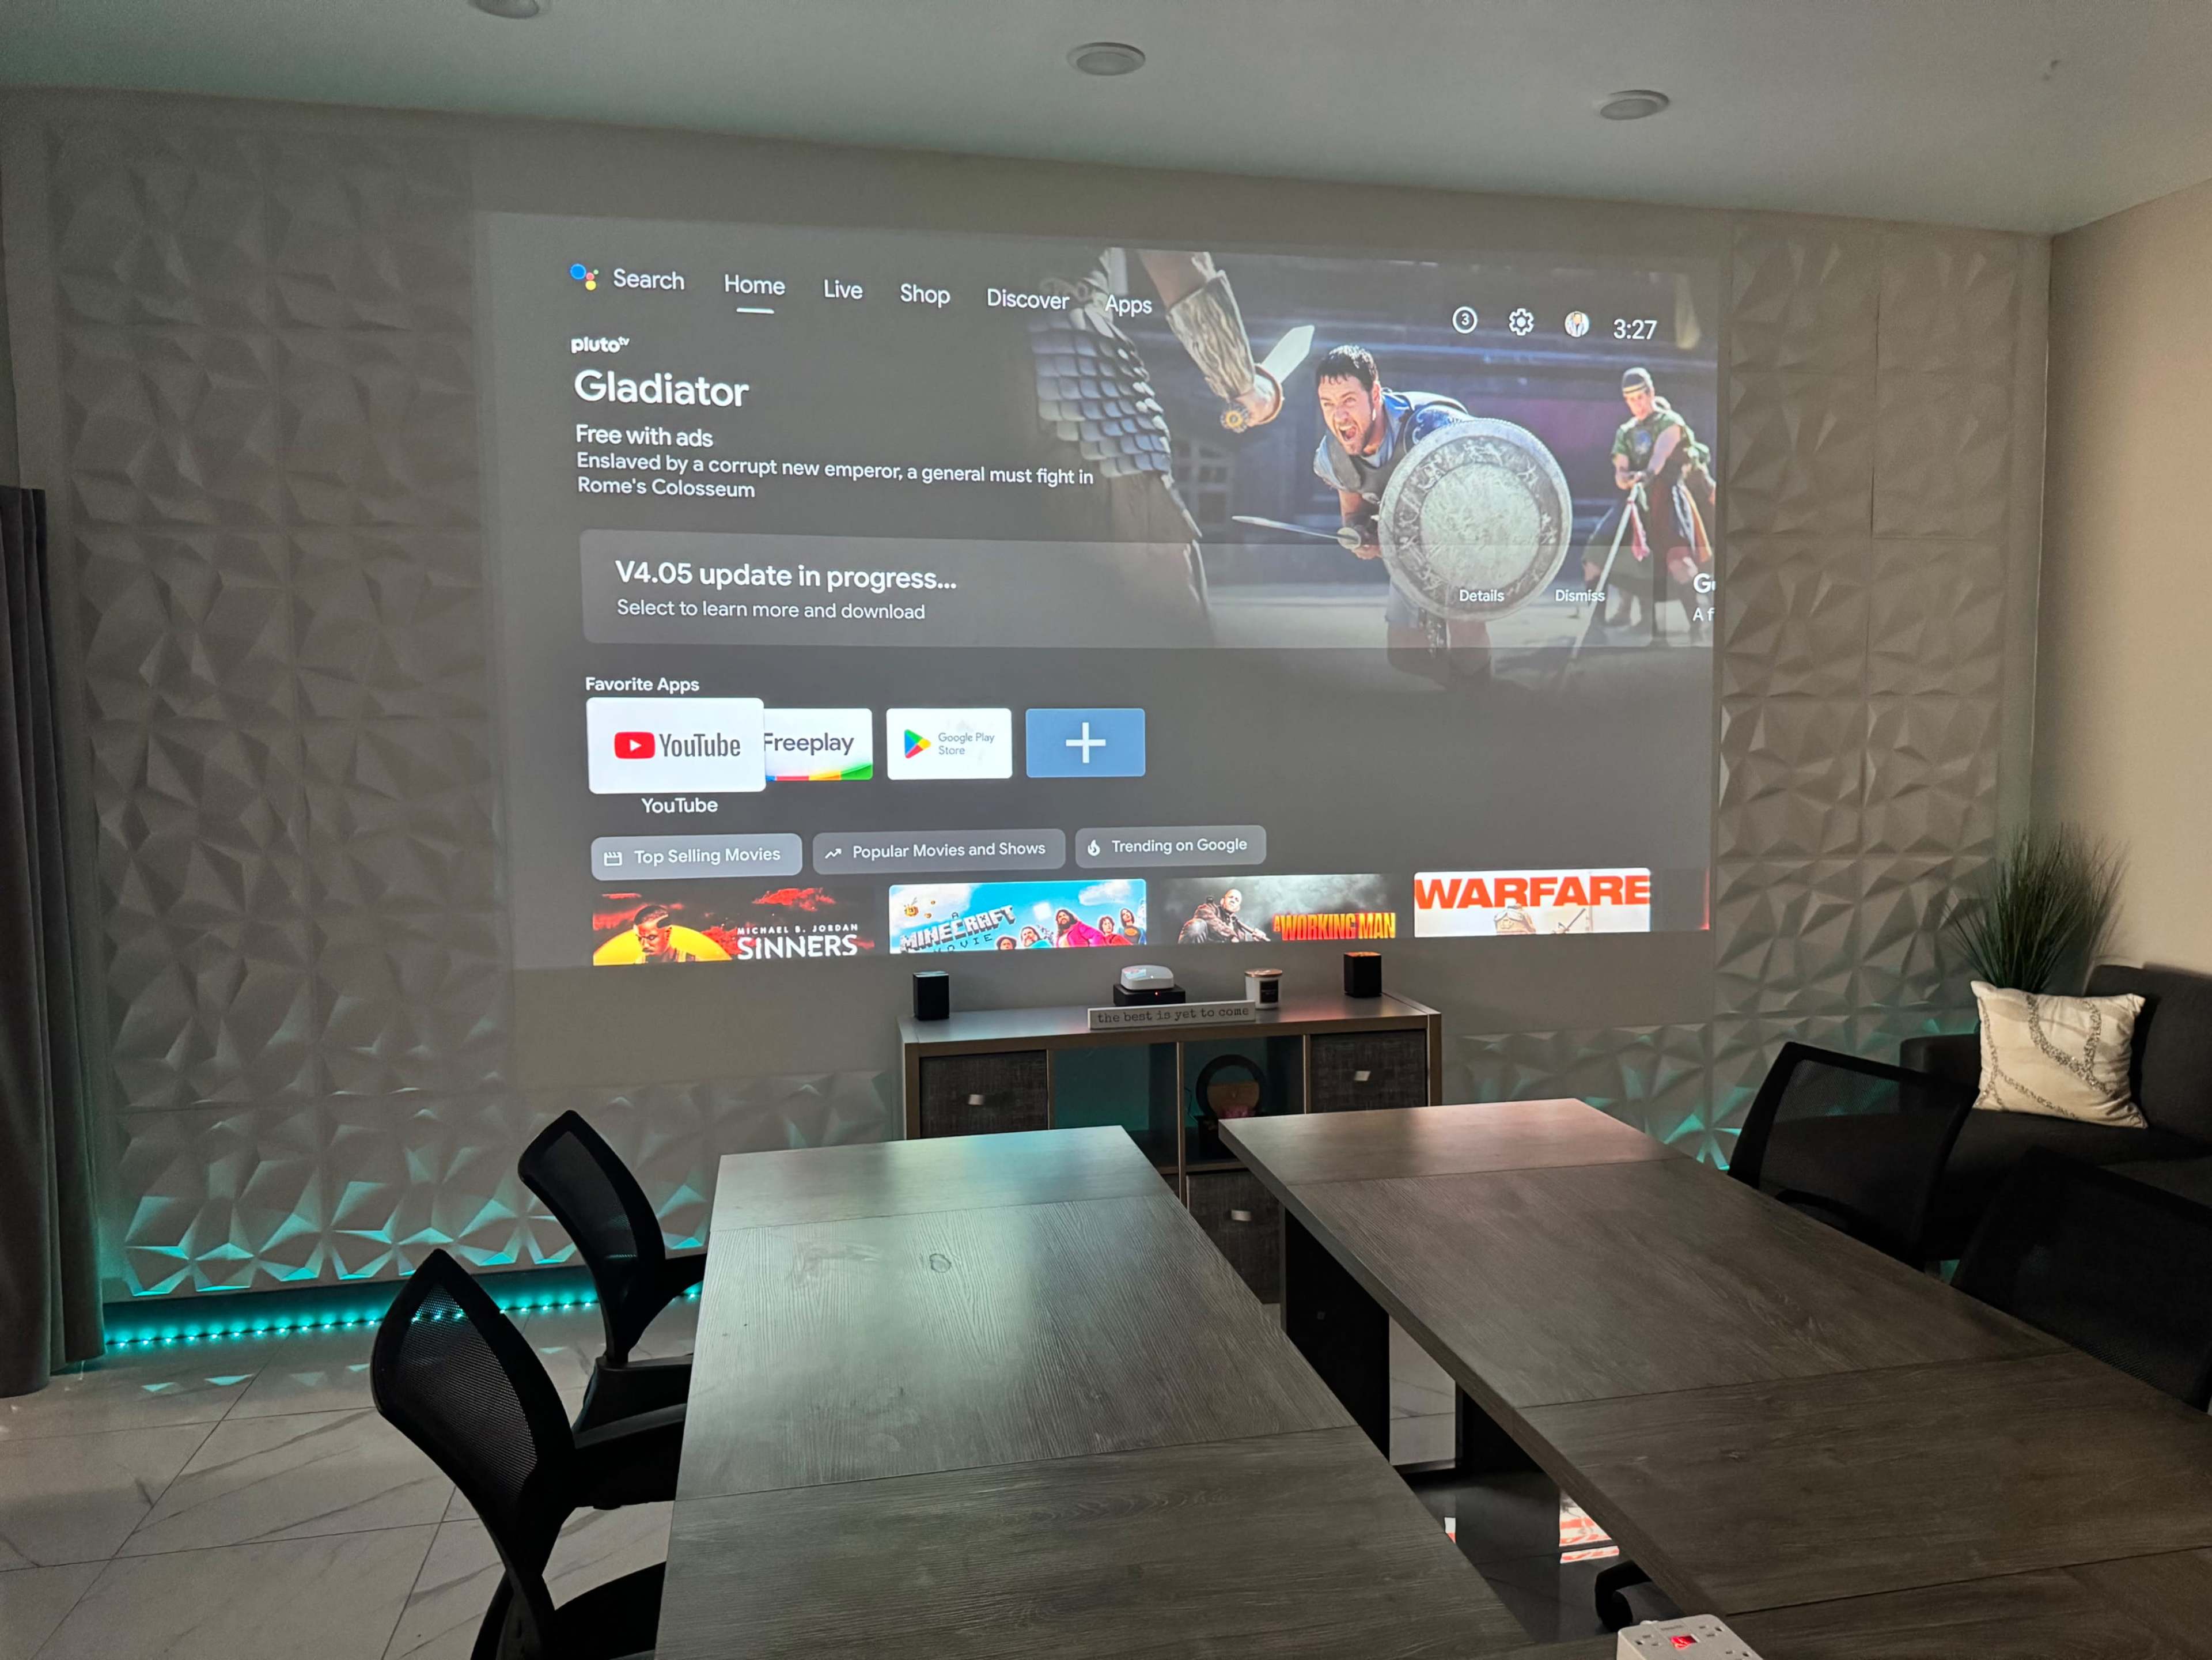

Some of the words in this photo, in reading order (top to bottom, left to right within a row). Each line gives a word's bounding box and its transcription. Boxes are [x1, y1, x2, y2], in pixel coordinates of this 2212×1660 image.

[613, 268, 685, 290] Search
[725, 274, 786, 295] Home
[824, 279, 863, 299] Live
[900, 283, 950, 308] Shop
[987, 288, 1070, 309] Discover
[1105, 295, 1152, 317] Apps
[1461, 313, 1469, 326] 3
[1613, 319, 1658, 340] 3:27
[574, 369, 749, 407] Gladiator
[576, 424, 622, 444] Free
[626, 426, 672, 446] with
[676, 428, 714, 447] ads
[577, 452, 661, 471] Enslaved
[666, 455, 688, 475] by
[693, 460, 703, 472] a
[709, 459, 777, 477] corrupt
[782, 463, 819, 476] new
[824, 466, 903, 481] emperor,
[907, 468, 917, 480] a
[922, 466, 985, 485] general
[990, 470, 1032, 483] must
[1036, 469, 1074, 488] fight
[1078, 470, 1093, 485] in
[578, 477, 646, 495] Rome's
[652, 478, 755, 498] Colosseum
[615, 560, 693, 584] V4.05
[699, 564, 793, 591] update
[798, 565, 820, 587] in
[827, 568, 957, 593] progress...
[1459, 589, 1505, 603] Details
[1555, 589, 1605, 603] Dismiss
[617, 599, 675, 617] Select
[679, 600, 698, 617] to
[702, 600, 748, 617] learn
[752, 604, 799, 618] more
[804, 602, 836, 619] and
[841, 603, 925, 620] download
[1692, 607, 1703, 621] A
[586, 677, 653, 691] Favorite
[657, 679, 700, 694] Apps
[659, 732, 741, 757] YouTube
[764, 732, 854, 755] Freeplay
[938, 732, 973, 744] Google
[976, 732, 995, 744] Play
[938, 745, 965, 755] Store
[642, 797, 718, 814] YouTube
[634, 849, 664, 866] Top
[668, 849, 721, 865] Selling
[725, 847, 781, 862] Movies
[853, 845, 909, 861] Popular
[913, 844, 965, 857] Movies
[969, 842, 995, 856] and
[999, 842, 1046, 855] Shows
[1112, 840, 1173, 854] Trending
[1176, 841, 1193, 853] on
[1197, 839, 1248, 854] Google
[1414, 875, 1651, 910] WARFARE
[737, 926, 788, 935] MICHAEL
[812, 924, 858, 932] JORDAN
[900, 905, 1016, 952] MINECRAFT
[1281, 913, 1356, 941] WORKING
[1358, 913, 1396, 939] MAN
[737, 934, 858, 960] SINNERS
[1098, 1012, 1120, 1023] the
[1124, 1011, 1153, 1022] best
[1156, 1009, 1171, 1020] is
[1175, 1009, 1196, 1021] yet
[1201, 1008, 1215, 1018] to
[1218, 1007, 1249, 1017] come
